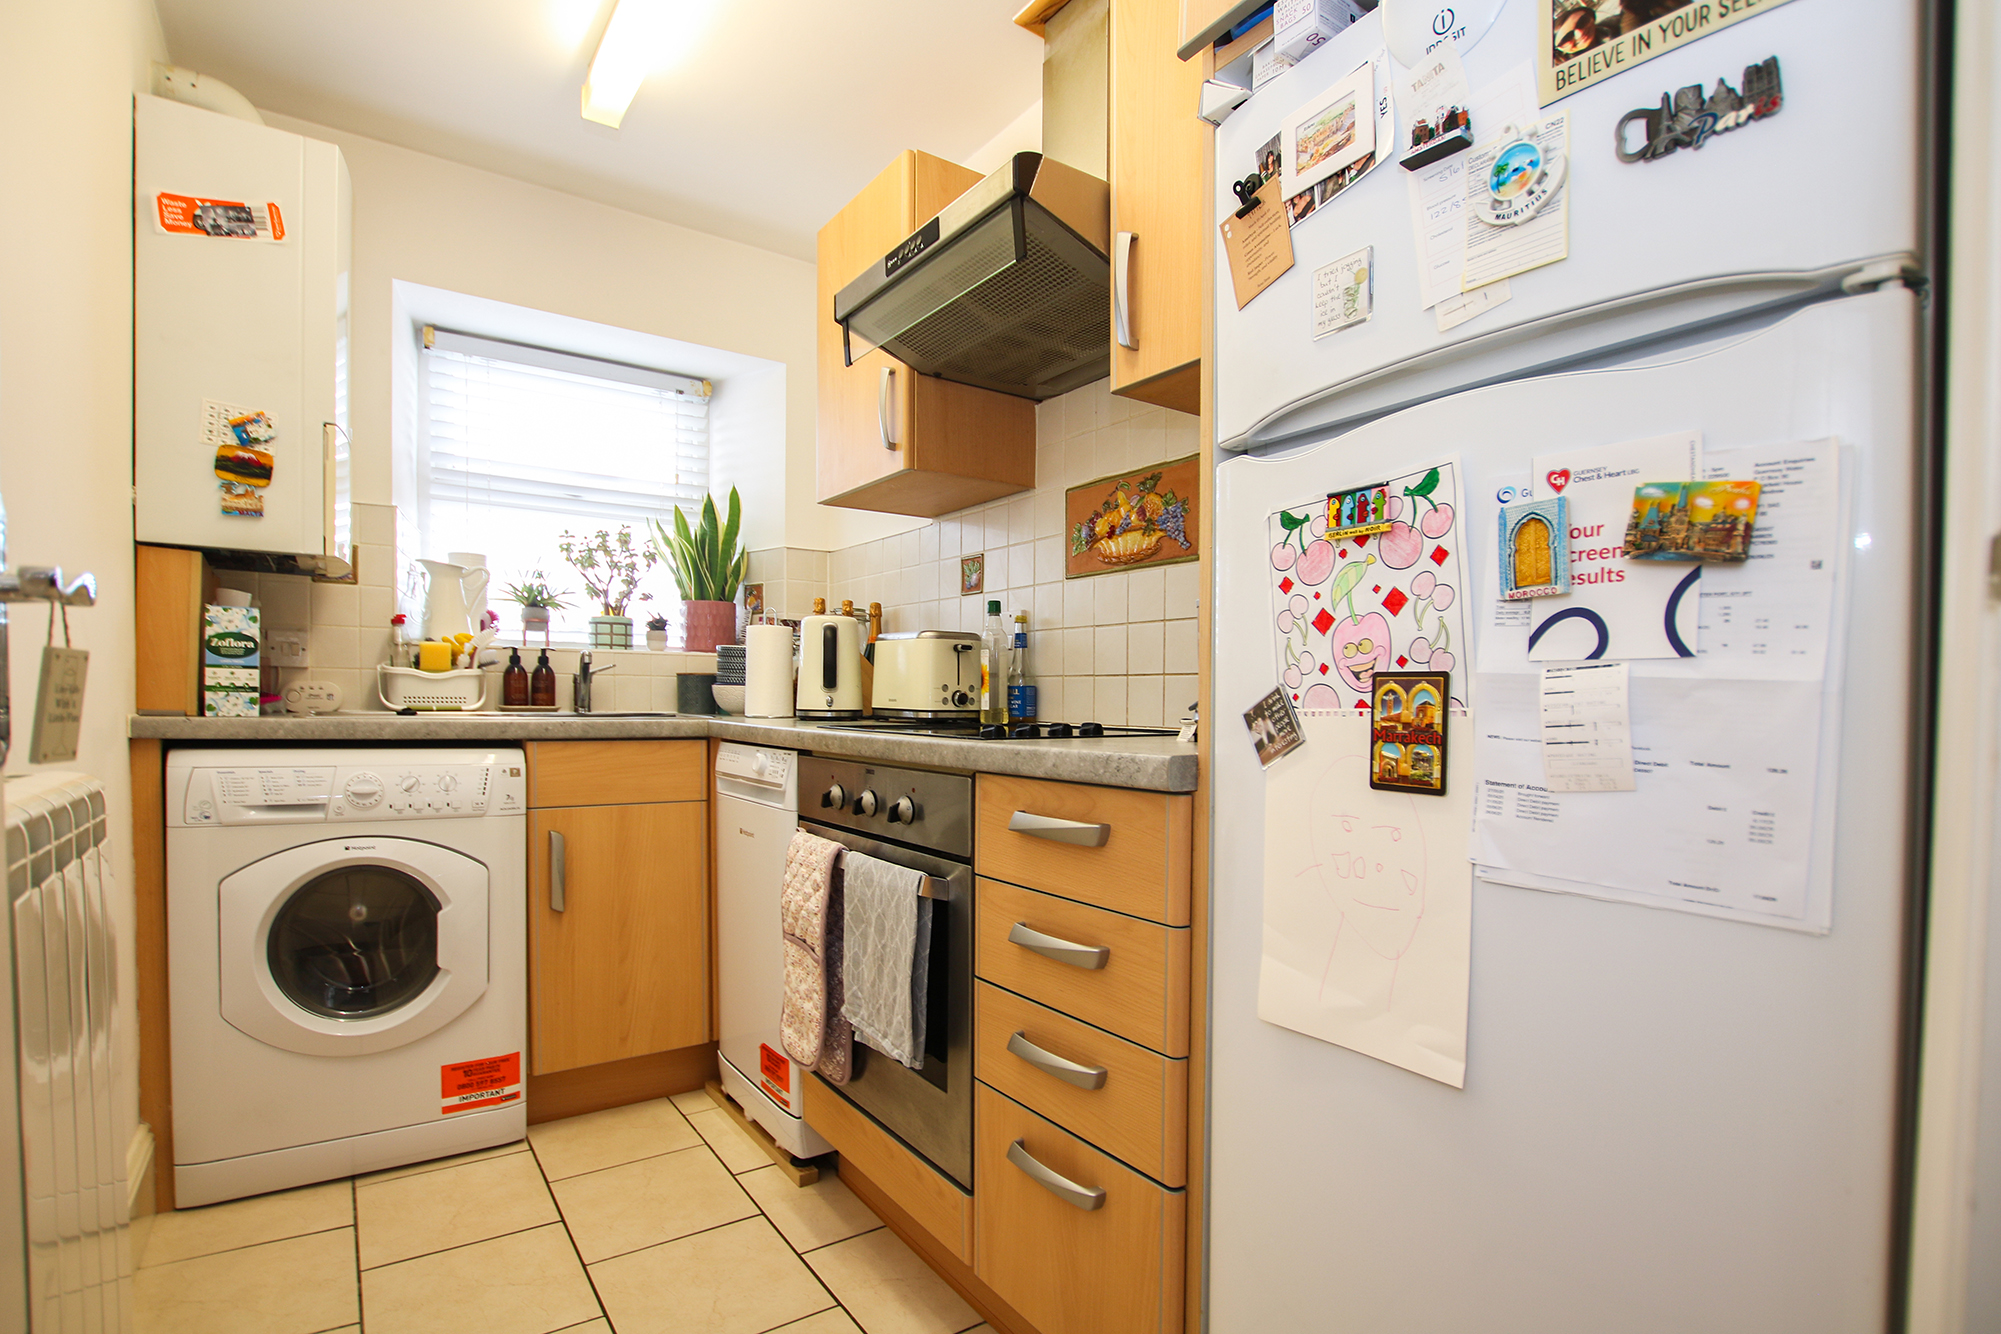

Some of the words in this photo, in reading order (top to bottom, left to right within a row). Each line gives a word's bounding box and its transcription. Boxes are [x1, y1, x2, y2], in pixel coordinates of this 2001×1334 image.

[1306, 32, 1326, 46] 50
[1556, 41, 1626, 91] BELIEVE
[1632, 29, 1651, 57] IN
[1659, 4, 1711, 44] YOUR
[1719, 0, 1766, 18] SEL
[1411, 62, 1445, 92] TANITA
[1379, 97, 1388, 119] YES
[1687, 95, 1782, 145] Paris
[161, 197, 187, 208] Waste
[1495, 188, 1548, 220] MAURITIUS
[164, 218, 193, 228] Money
[1573, 472, 1595, 483] Chest
[1596, 472, 1602, 480] &
[1604, 470, 1627, 479] Heart
[1569, 523, 1605, 539] our
[1570, 546, 1624, 562] creen
[1571, 567, 1625, 585] esults
[1508, 587, 1558, 599] MOROCCO
[210, 637, 255, 649] Zoflora
[1374, 729, 1442, 745] Marrakech
[1485, 779, 1516, 788] Statement
[459, 1089, 505, 1102] IMPORTANT
